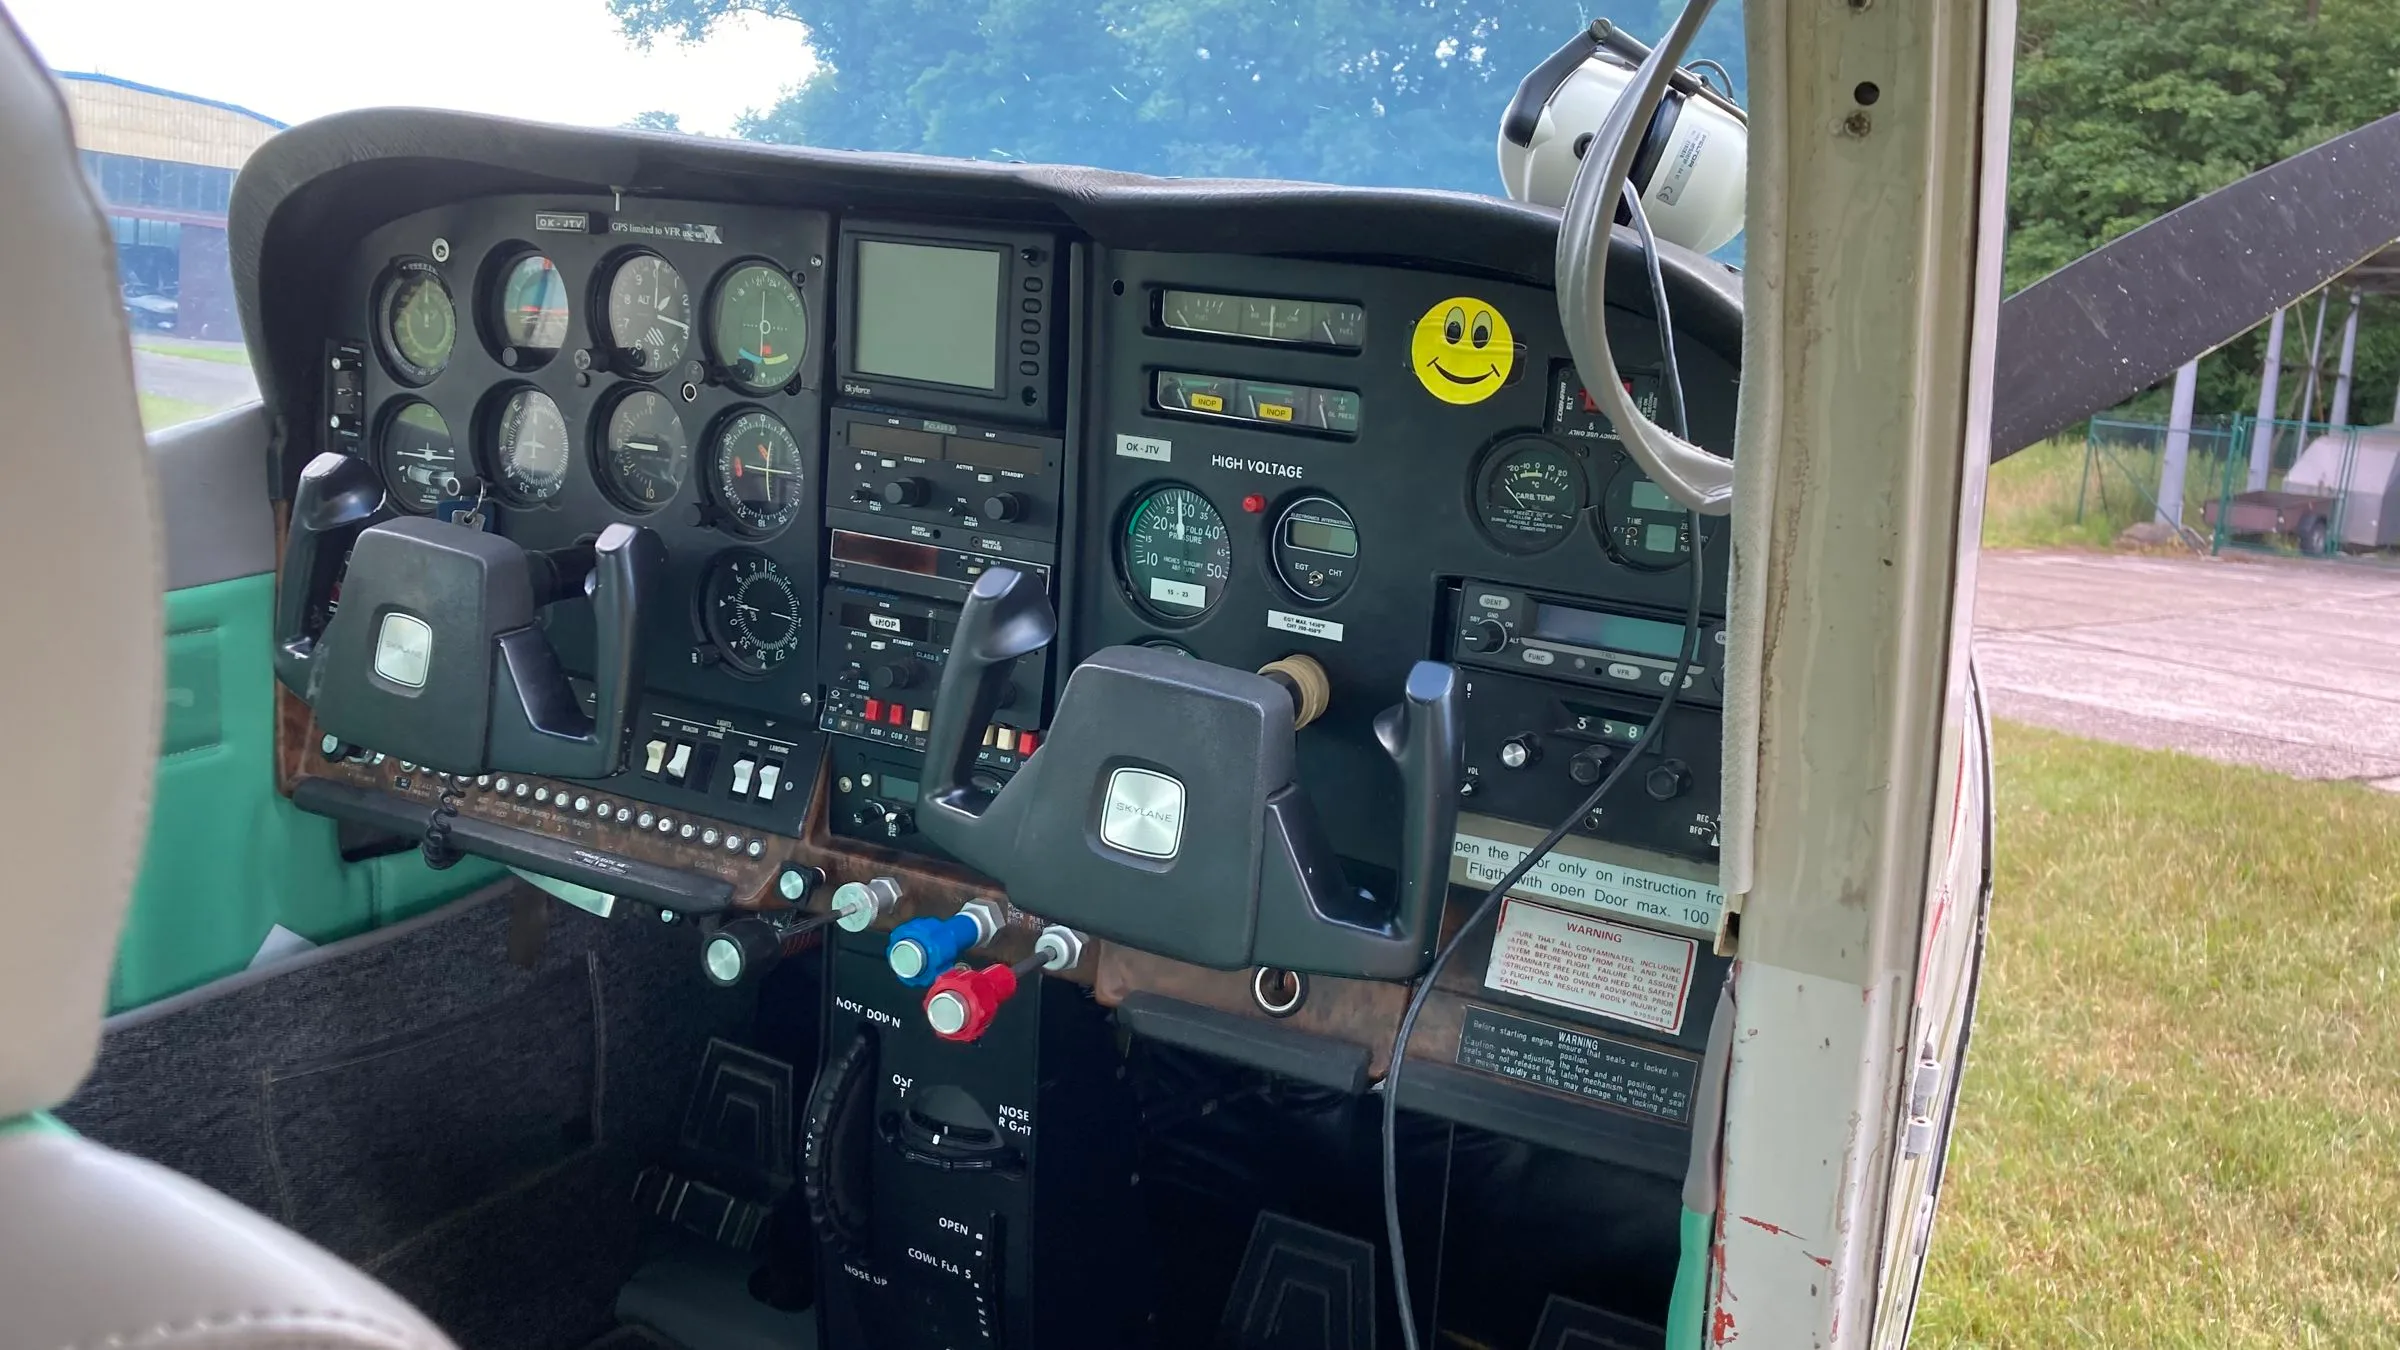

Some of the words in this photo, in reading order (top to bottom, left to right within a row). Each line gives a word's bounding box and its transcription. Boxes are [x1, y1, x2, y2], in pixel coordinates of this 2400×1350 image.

[539, 218, 555, 227] OK
[563, 219, 583, 228] JTV
[612, 223, 628, 232] GPS
[629, 224, 654, 235] limited
[655, 226, 663, 235] to
[664, 227, 681, 237] VFR
[638, 295, 650, 305] ALT
[845, 384, 871, 395] Skyforce
[1198, 398, 1217, 408] INOP
[1266, 408, 1286, 418] INOP
[1569, 429, 1585, 437] ONLY
[1587, 431, 1599, 439] USE
[1126, 442, 1139, 453] OK
[1145, 444, 1160, 455] JTV
[904, 456, 926, 464] STANDBY
[956, 464, 974, 472] ACTIVE
[1212, 455, 1243, 471] HIGH
[1247, 460, 1303, 479] VOLTAGE
[1001, 471, 1025, 479] STANDBY
[646, 488, 655, 499] 10
[1166, 506, 1175, 514] 25
[1182, 504, 1195, 518] 30
[965, 515, 978, 523] PULL
[1200, 512, 1208, 521] 35
[1627, 517, 1643, 526] TIME
[963, 520, 979, 528] IDENT
[1153, 516, 1168, 531] 20
[911, 530, 931, 538] RELEASE
[1205, 525, 1220, 540] 40
[1217, 548, 1226, 557] 45
[1147, 552, 1158, 567] 10
[768, 562, 777, 573] 12
[1207, 563, 1222, 579] 50
[1295, 562, 1309, 571] EGT
[1329, 569, 1343, 577] CHT
[1484, 597, 1503, 607] IDENT
[1487, 612, 1499, 620] GND
[1505, 621, 1514, 629] ON
[740, 636, 751, 650] 33
[893, 639, 914, 647] STANDBY
[756, 649, 767, 660] 30
[776, 649, 785, 661] 27
[916, 652, 934, 661] CLASS
[1528, 653, 1545, 662] FUNC
[1617, 668, 1630, 676] VFR
[1577, 717, 1587, 730] 3
[1628, 726, 1637, 738] 8
[769, 745, 790, 754] LANDING
[1467, 766, 1479, 776] VOL
[1116, 802, 1173, 823] SKYLANE
[1697, 813, 1709, 824] REC
[1689, 825, 1703, 836] BFO
[1455, 840, 1480, 855] pen
[1488, 845, 1509, 861] the
[1519, 851, 1551, 870] Dor
[1558, 861, 1587, 878] only
[1596, 870, 1613, 882] on
[1622, 871, 1697, 899] instruction
[1469, 862, 1506, 881] Fligth
[1515, 873, 1542, 889] with
[1551, 881, 1585, 900] open
[1594, 889, 1629, 908] Door
[1637, 900, 1671, 917] max.
[1682, 908, 1710, 925] 100
[1567, 922, 1622, 943] WARNING
[1538, 934, 1556, 944] THAT
[1560, 939, 1572, 948] ALL
[1640, 960, 1682, 975] INCLUDING
[1534, 942, 1548, 952] ARE
[1552, 946, 1588, 961] REMOVED
[1592, 954, 1613, 967] FROM
[1617, 962, 1636, 973] FUEL
[1640, 967, 1657, 978] AND
[1661, 972, 1680, 983] FUEL
[1534, 951, 1562, 964] BEFORE
[1566, 958, 1591, 971] FLIGHT
[1598, 966, 1628, 980] FAILURE
[1648, 978, 1678, 992] ASSURE
[1553, 963, 1571, 974] FREE
[1572, 968, 1591, 979] FUEL
[1592, 973, 1609, 984] AND
[1610, 977, 1630, 989] HEED
[1632, 982, 1646, 992] ALL
[1647, 986, 1677, 999] SAFETY
[1510, 971, 1534, 983] FLIGHT
[1538, 977, 1554, 987] CAN
[1557, 982, 1584, 994] RESULT
[1600, 993, 1627, 1005] BODILY
[1630, 1000, 1658, 1013] INJURY
[1661, 1008, 1673, 1017] OR
[1553, 973, 1569, 982] AND
[1573, 977, 1601, 990] OWNER
[1604, 985, 1648, 1002] ADVISORIES
[1652, 997, 1674, 1008] PRIOR
[1558, 1031, 1599, 1050] WARNING
[1473, 1020, 1496, 1034] Before
[1500, 1027, 1528, 1042] starting
[1531, 1035, 1554, 1047] engine
[1558, 1042, 1582, 1054] ensure
[1587, 1045, 1601, 1059] that
[1644, 1061, 1667, 1076] locked
[1559, 1051, 1590, 1066] position.
[1500, 1046, 1519, 1058] when
[1523, 1052, 1555, 1068] adjusting
[1559, 1060, 1571, 1072] the
[1575, 1063, 1590, 1075] fore
[1594, 1068, 1608, 1080] and
[1627, 1076, 1656, 1093] position
[1514, 1058, 1541, 1073] release
[1545, 1064, 1557, 1076] the
[1560, 1069, 1579, 1082] latch
[1583, 1074, 1624, 1092] mechanism
[1628, 1084, 1647, 1098] while
[1652, 1091, 1664, 1103] the
[1475, 1058, 1499, 1072] moving
[1503, 1064, 1528, 1079] rapidly
[1545, 1074, 1559, 1085] this
[1563, 1079, 1579, 1092] may
[1583, 1084, 1611, 1100] damage
[1616, 1091, 1628, 1103] the
[1632, 1095, 1658, 1113] locking
[1662, 1105, 1678, 1117] pins
[999, 1104, 1030, 1122] NOSE
[998, 1117, 1032, 1136] RGHT
[939, 1217, 969, 1236] OPEN
[908, 1247, 938, 1267] COWL
[941, 1260, 972, 1279] FLAS
[844, 1263, 871, 1283] NOSE
[873, 1275, 888, 1287] UP
